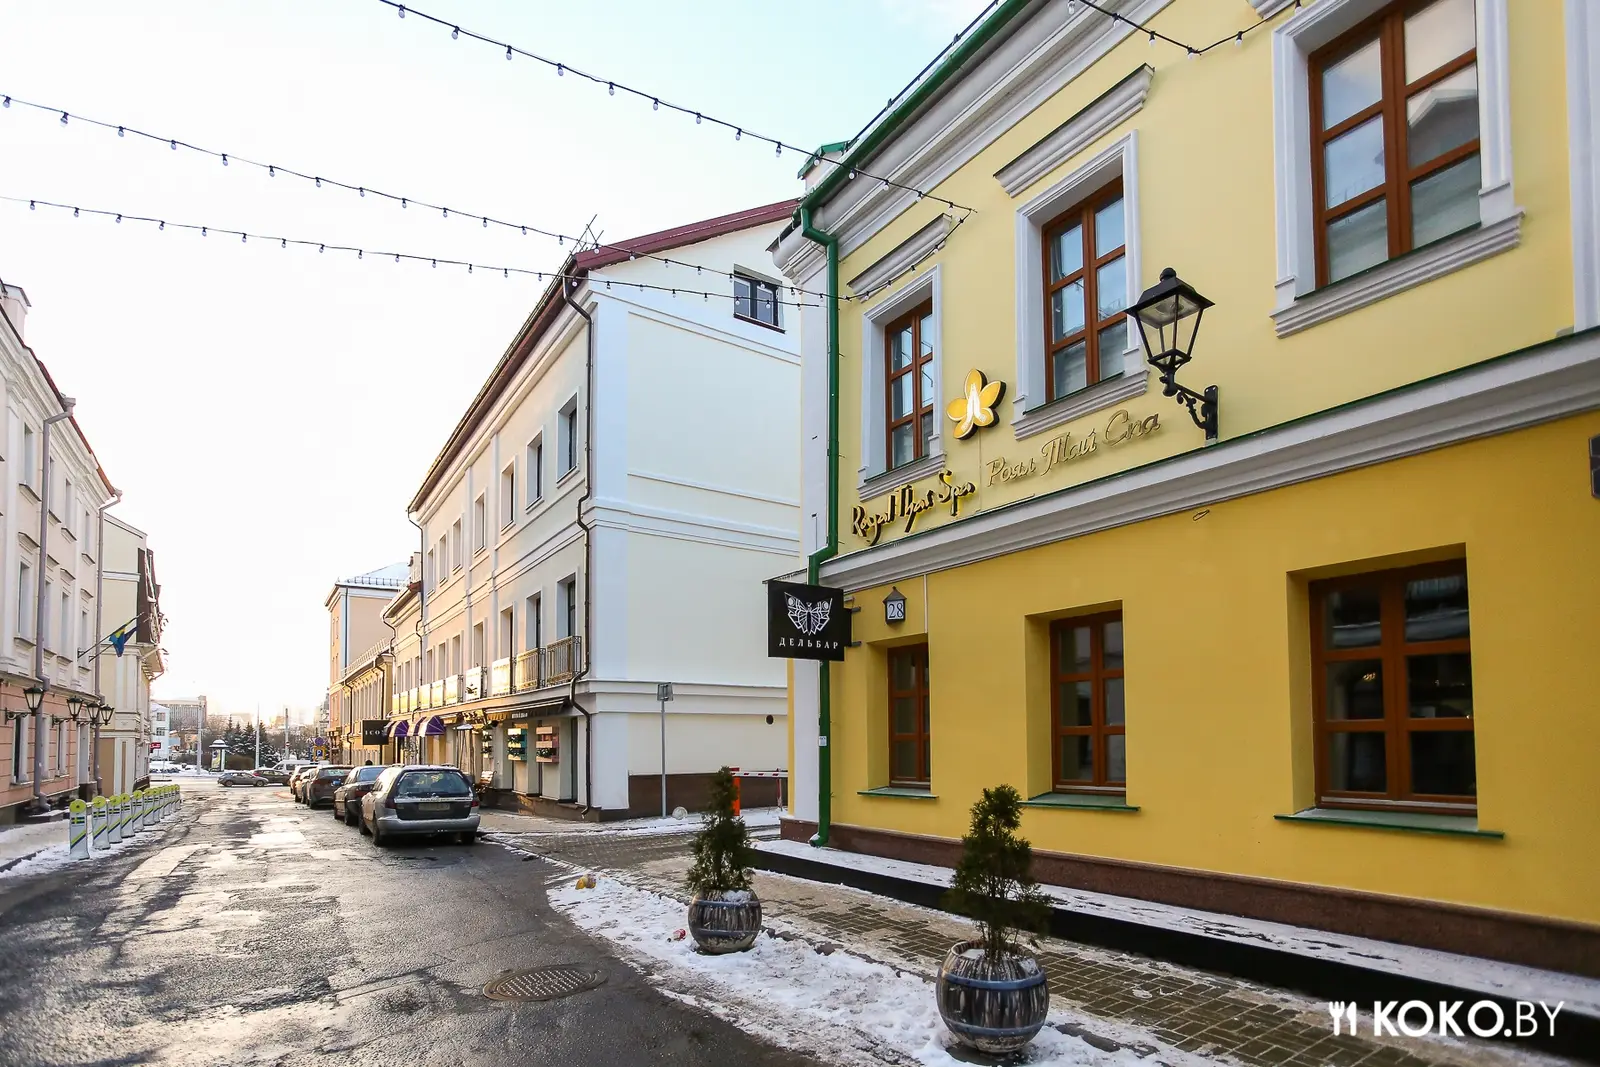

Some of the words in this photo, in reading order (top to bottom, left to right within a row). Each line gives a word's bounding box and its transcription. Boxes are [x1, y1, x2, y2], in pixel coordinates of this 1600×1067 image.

[986, 456, 1037, 488] Роял
[1040, 427, 1098, 477] Тай
[1102, 408, 1161, 448] Спа
[852, 494, 897, 547] Royal
[896, 484, 935, 534] Thai
[938, 468, 977, 517] Spa
[888, 602, 904, 619] 28
[779, 636, 839, 650] ДЕЛЬБАР
